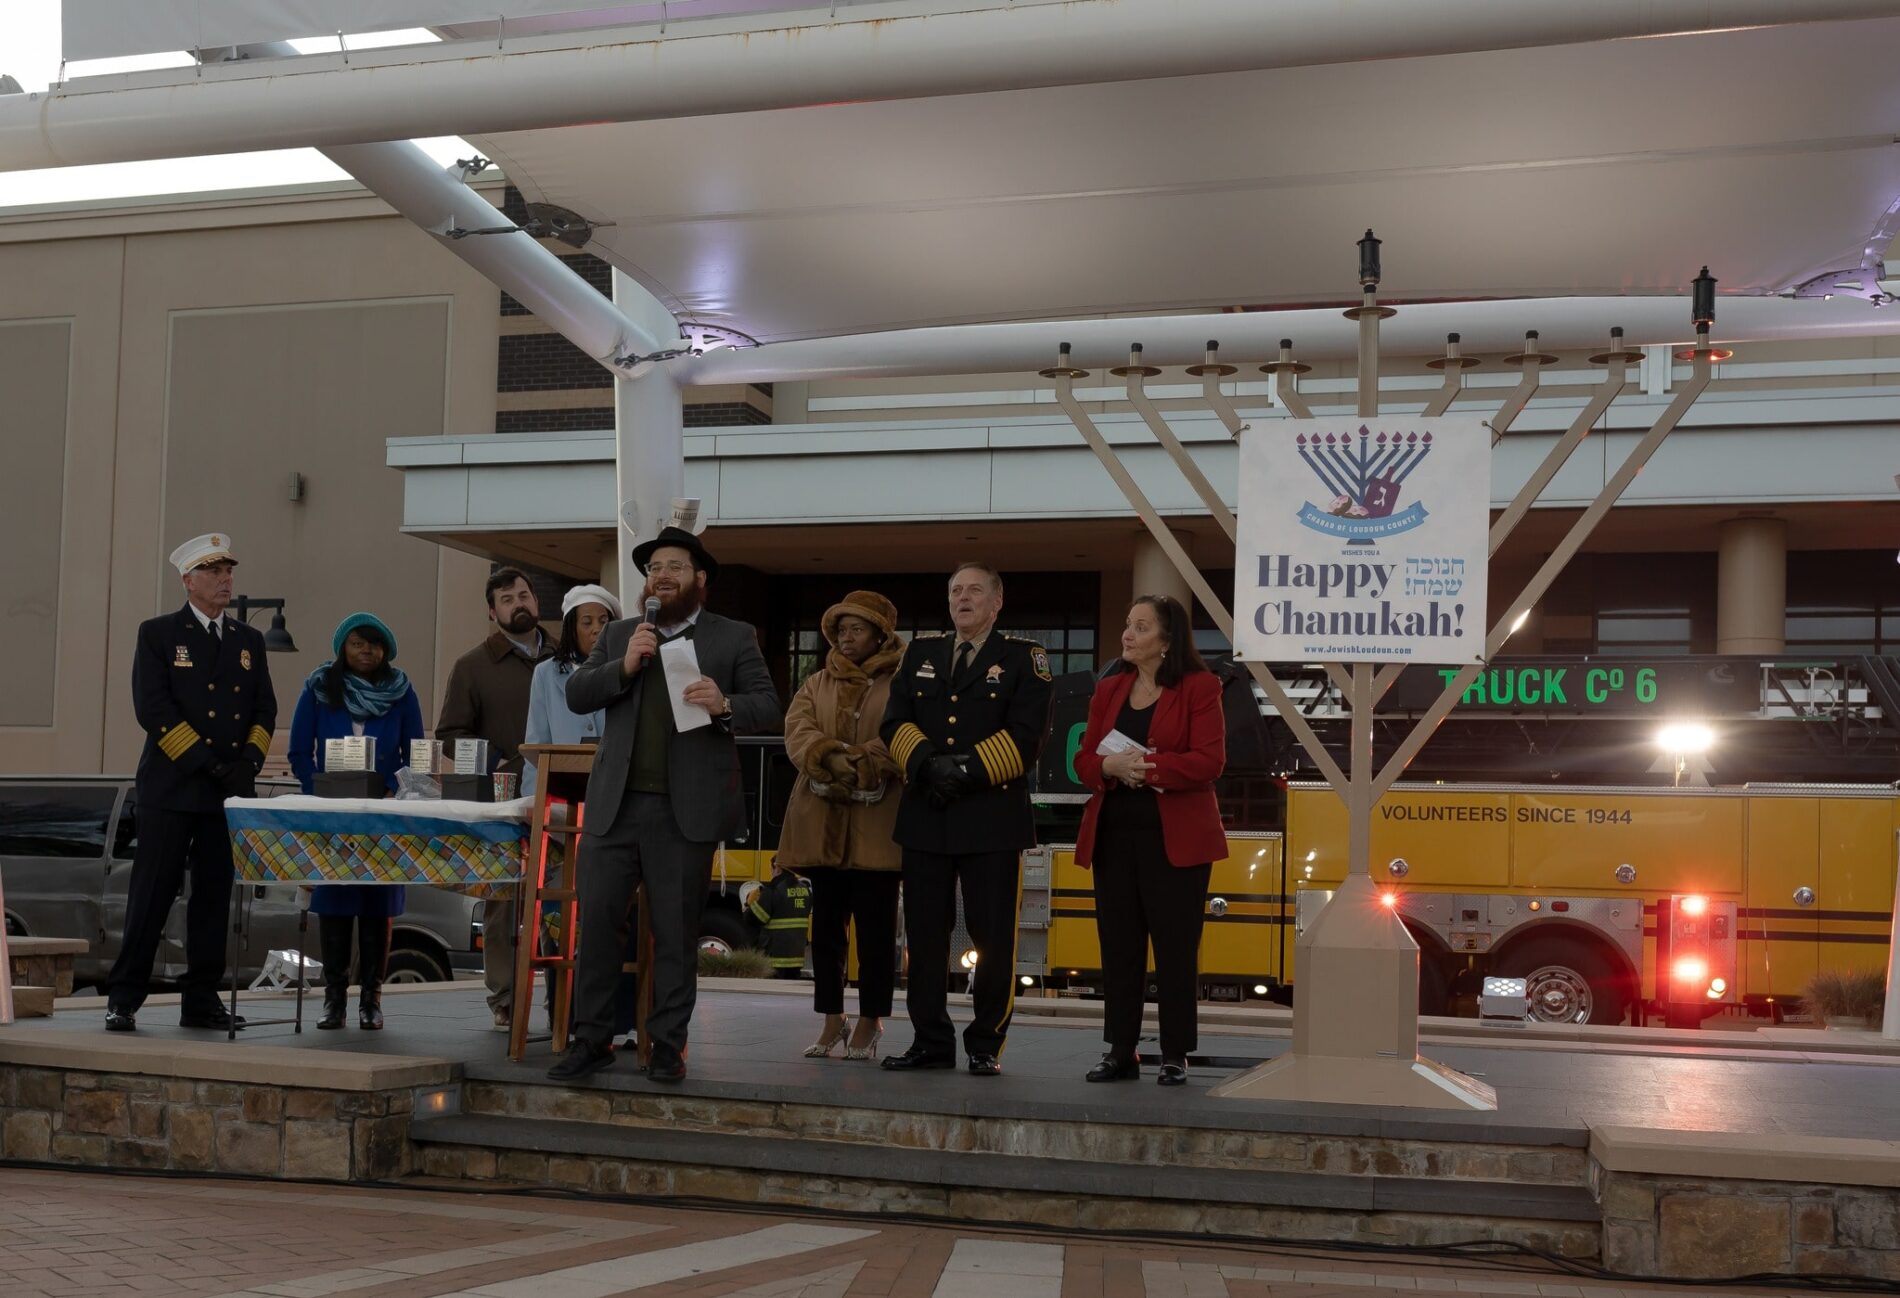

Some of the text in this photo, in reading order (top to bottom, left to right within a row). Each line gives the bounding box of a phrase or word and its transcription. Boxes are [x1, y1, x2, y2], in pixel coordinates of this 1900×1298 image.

[1306, 513, 1416, 533] CHABAD OF LOUDOUN COUNTY
[1255, 554, 1398, 599] Happy
[1405, 557, 1465, 576] חנוכה
[1253, 600, 1465, 638] Chanukah!
[1303, 645, 1412, 655] www.JewishLoudoun.com
[1635, 668, 1657, 704] 6
[1381, 805, 1633, 825] VOLUNTEERS SINCE 1944
